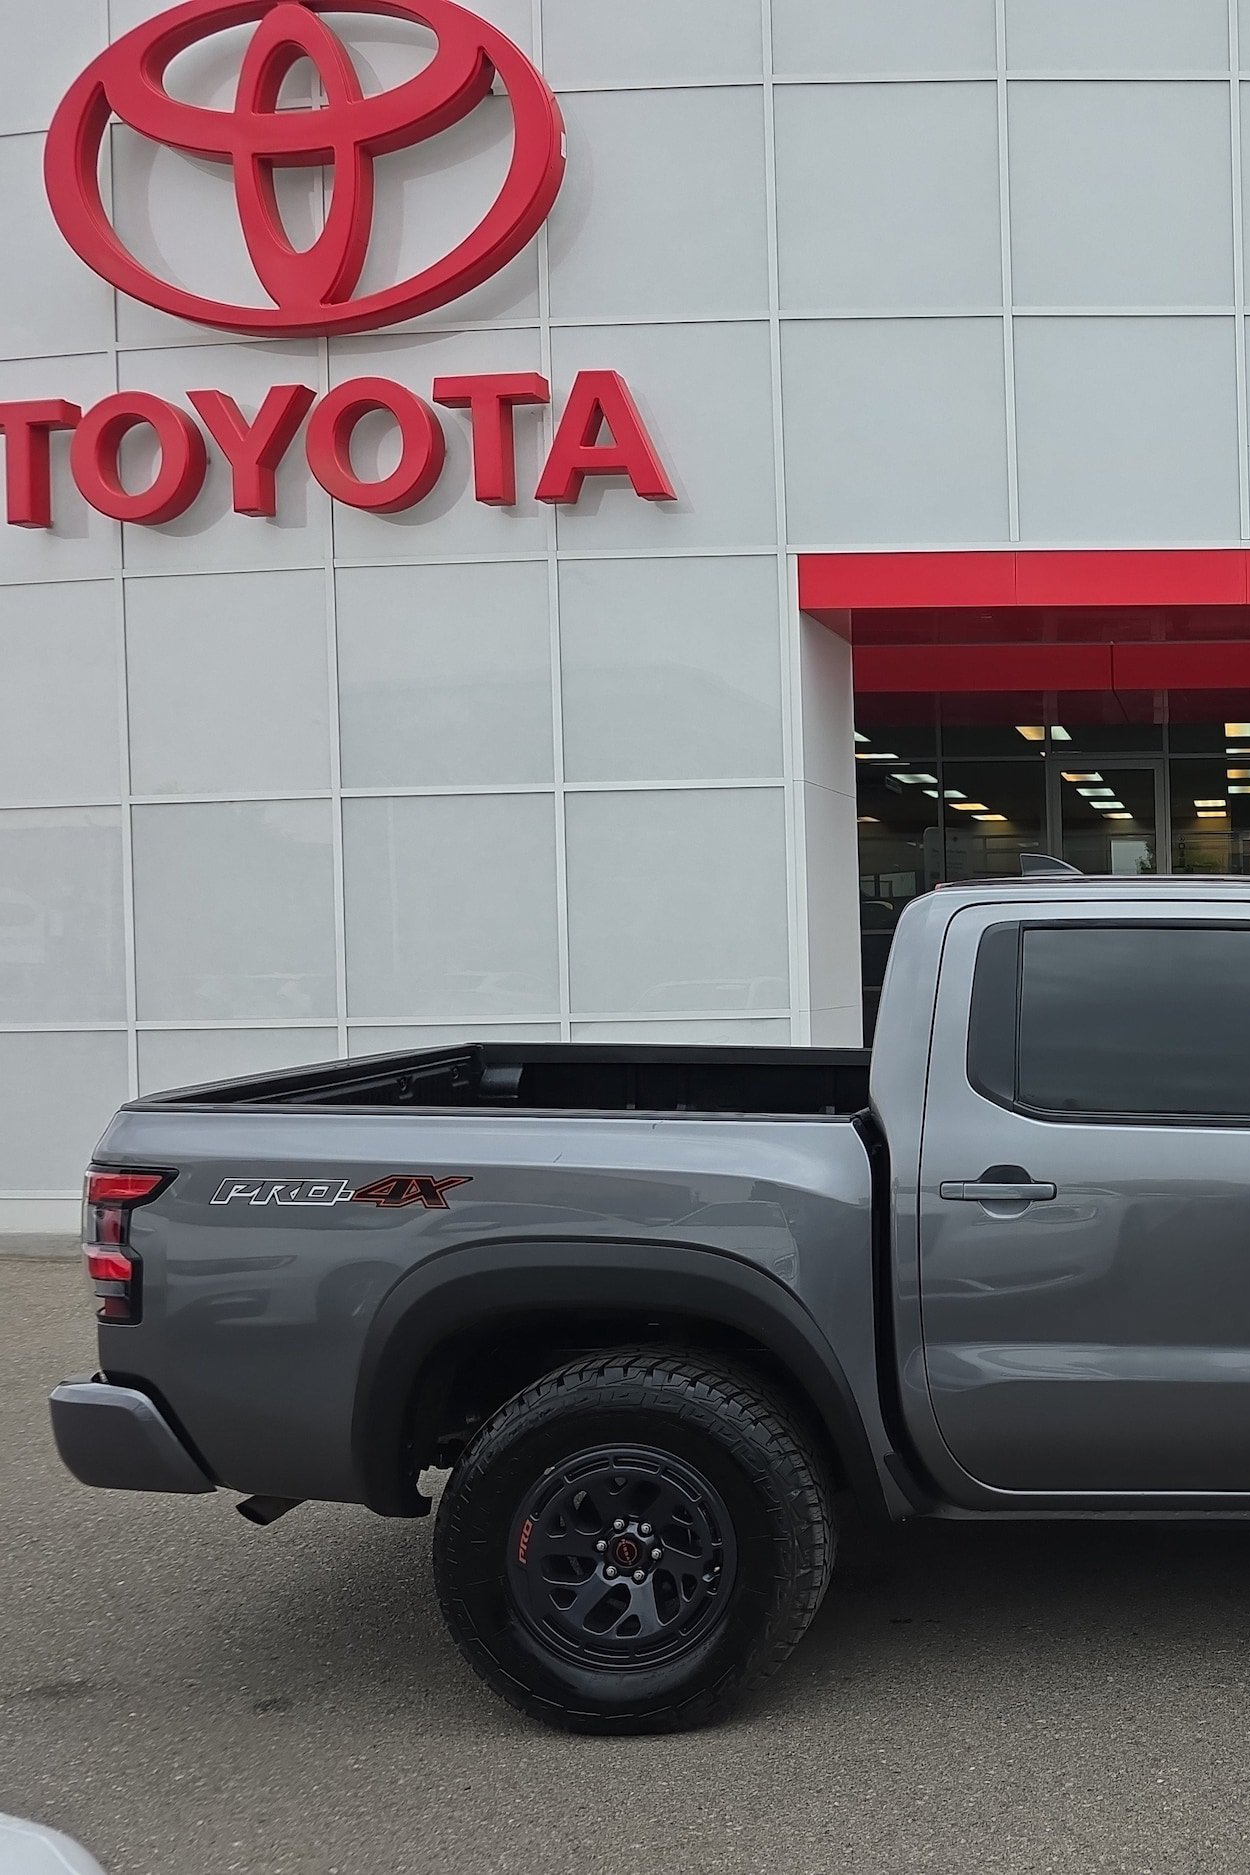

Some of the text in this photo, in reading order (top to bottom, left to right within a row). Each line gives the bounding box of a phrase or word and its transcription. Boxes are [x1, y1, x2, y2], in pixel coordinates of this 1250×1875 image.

[0, 369, 677, 529] TOYOTA
[210, 1174, 474, 1209] PRO-4X
[519, 1519, 533, 1564] PRO
